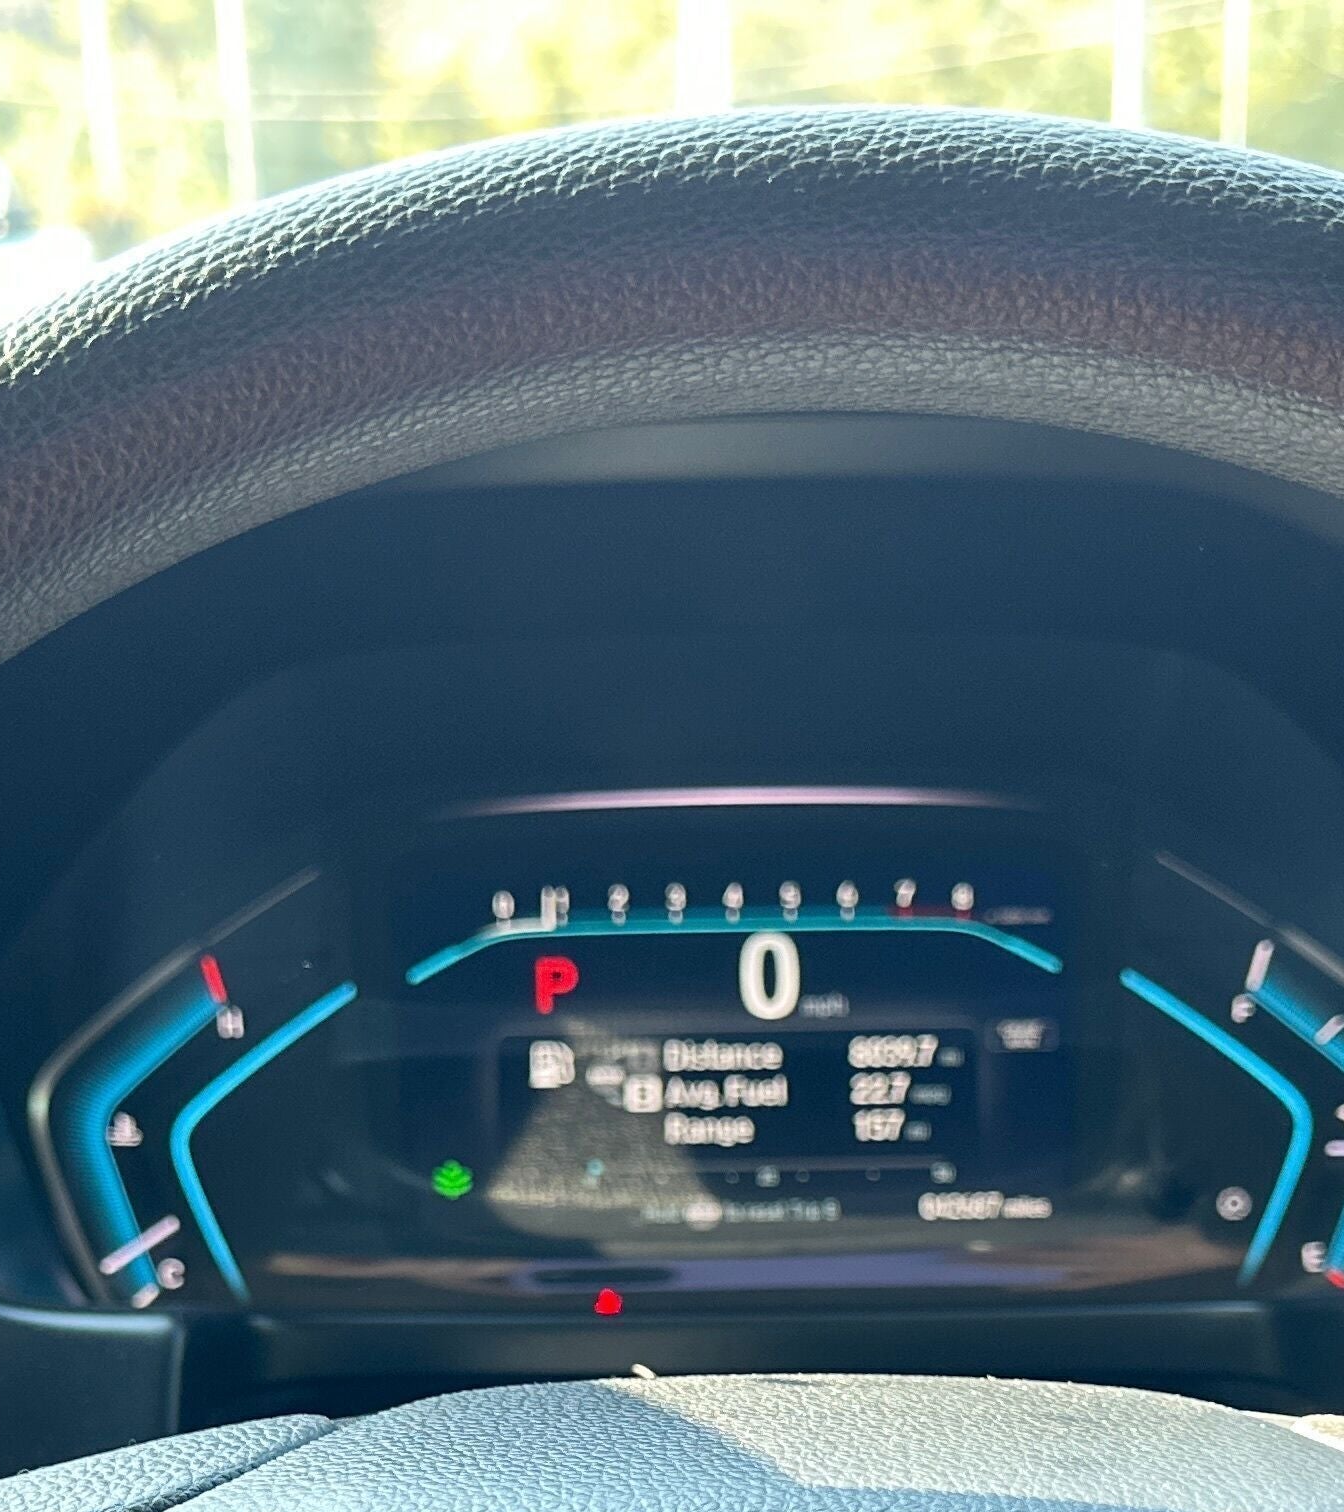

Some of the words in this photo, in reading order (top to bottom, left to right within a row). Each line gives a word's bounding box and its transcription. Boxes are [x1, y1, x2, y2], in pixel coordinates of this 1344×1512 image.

[894, 878, 916, 907] 7
[535, 955, 579, 1014] P
[738, 930, 801, 1021] 0
[662, 1037, 784, 1072] Distance
[723, 1073, 789, 1108] Fuel
[663, 1112, 756, 1147] Range
